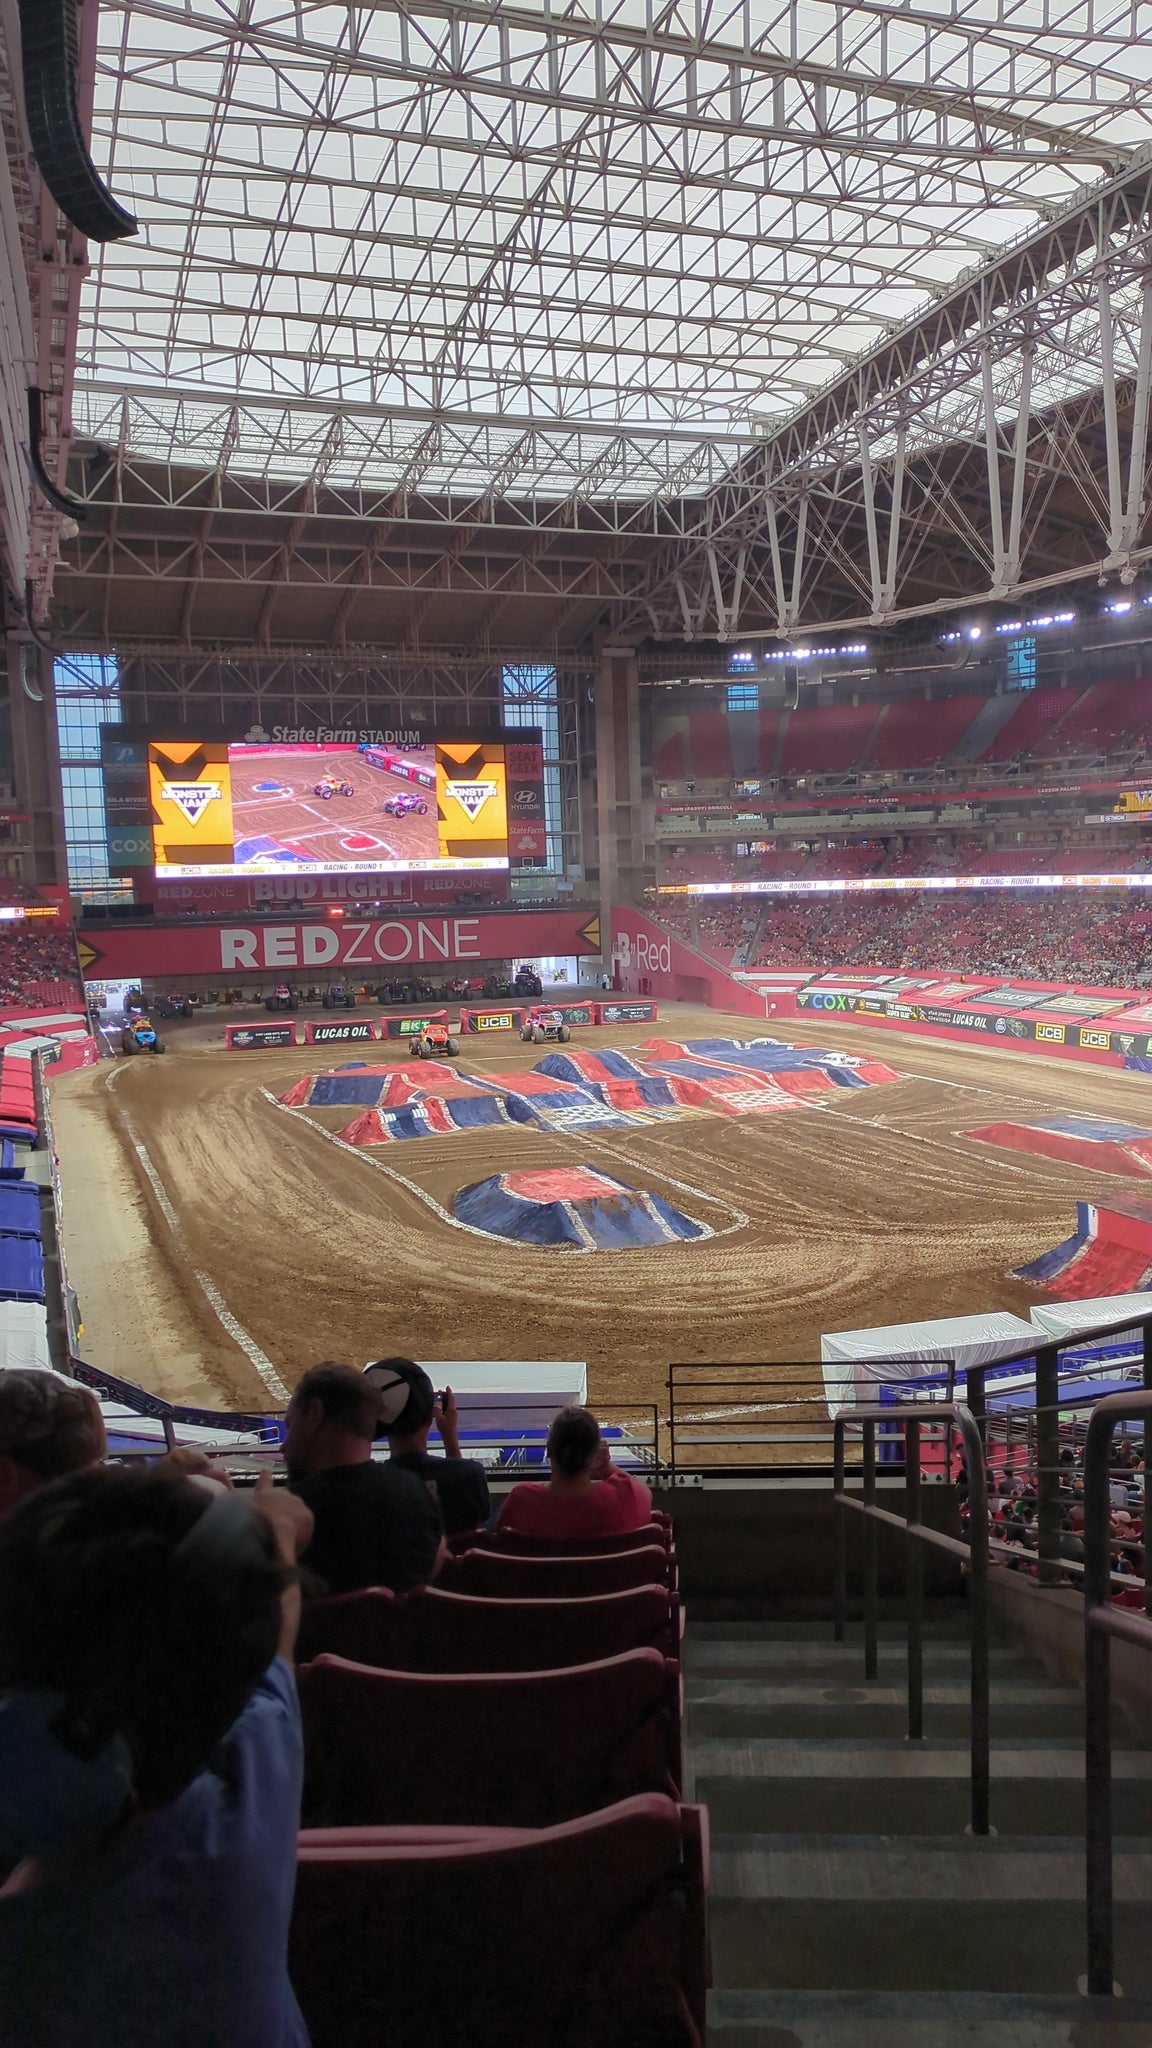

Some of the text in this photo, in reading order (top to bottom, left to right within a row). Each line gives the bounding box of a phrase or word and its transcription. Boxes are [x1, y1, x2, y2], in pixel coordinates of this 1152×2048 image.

[359, 730, 420, 743] STADIUM
[509, 751, 538, 760] SEAT
[509, 763, 538, 774] GEEK
[160, 789, 222, 800] MONSTER
[444, 787, 498, 798] MONSTER
[177, 798, 208, 808] JAM
[461, 796, 486, 805] JAM
[111, 839, 151, 853] COX
[255, 875, 407, 900] BUD LIGHT
[980, 878, 1004, 886] RACING
[220, 919, 481, 969] REDZONE
[636, 933, 671, 973] Red
[812, 994, 847, 1011] COX
[400, 1020, 430, 1033] BKT
[480, 1017, 511, 1027] JCB
[952, 1013, 974, 1026] LUCAS
[974, 1017, 988, 1029] OIL
[315, 1025, 369, 1039] LUCAS OIL
[1038, 1026, 1063, 1039] JCB
[1082, 1032, 1108, 1046] JCB
